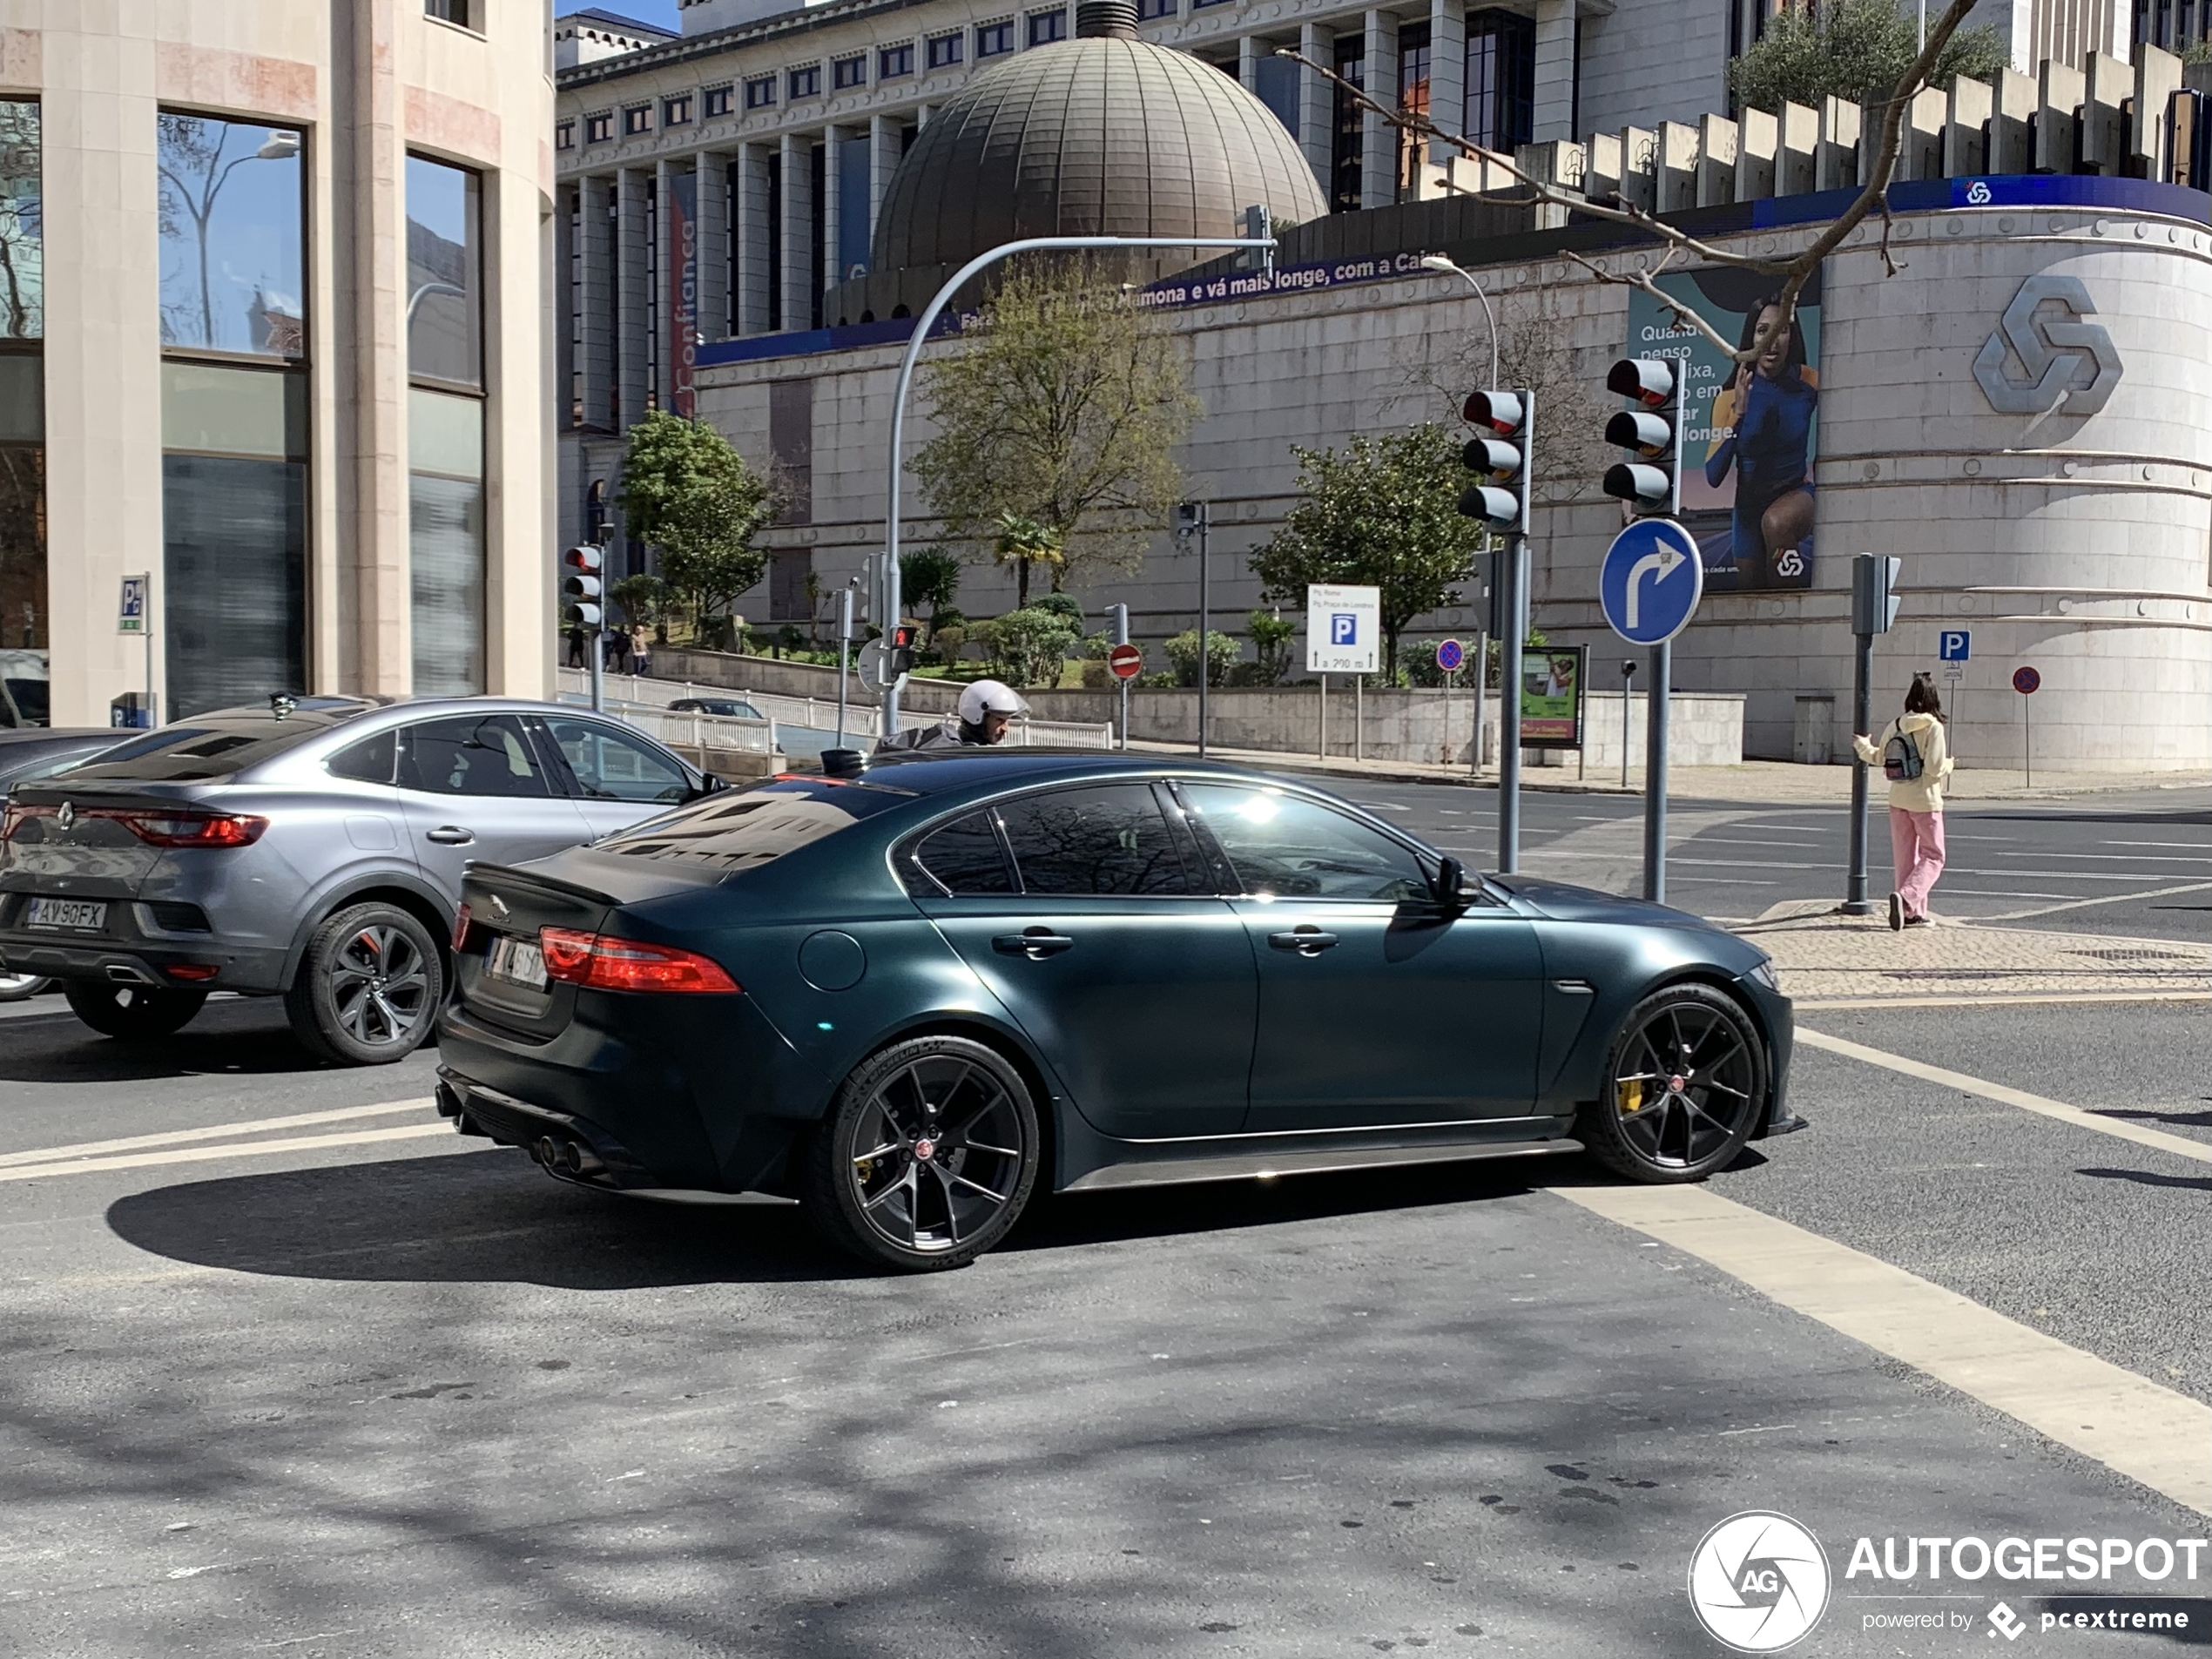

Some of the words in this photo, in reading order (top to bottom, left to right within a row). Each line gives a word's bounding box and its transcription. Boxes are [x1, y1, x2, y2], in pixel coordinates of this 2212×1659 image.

[1191, 286, 1202, 300] e
[1207, 280, 1226, 298] vá
[1231, 276, 1271, 295] mais
[1275, 268, 1330, 289] longe,
[1334, 262, 1373, 280] com
[1379, 259, 1390, 274] a
[1641, 325, 1705, 342] Quand
[1696, 384, 1723, 398] em
[1683, 426, 1737, 442] longe.
[1335, 618, 1352, 643] P
[1946, 633, 1964, 658] P
